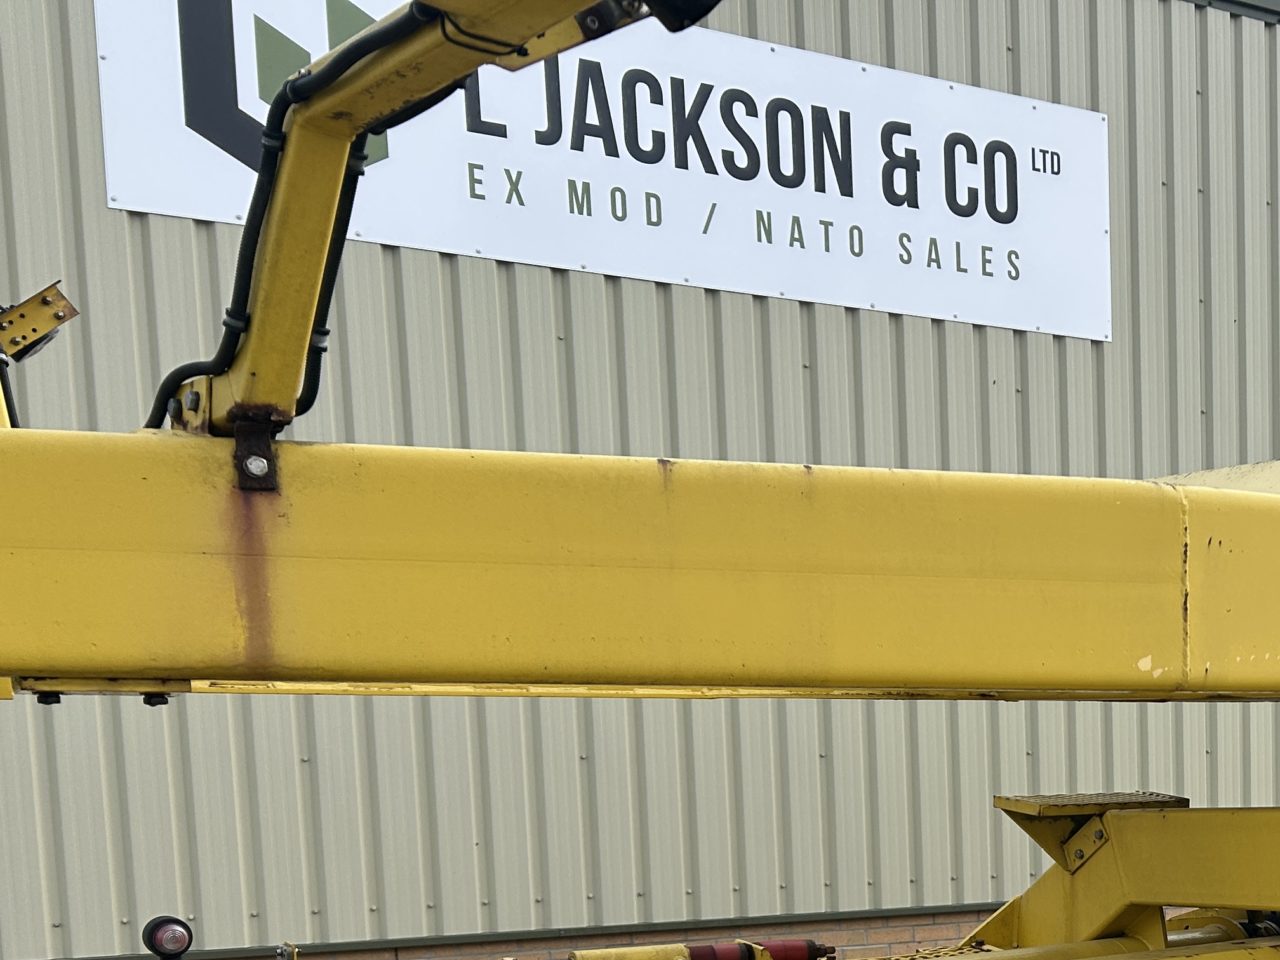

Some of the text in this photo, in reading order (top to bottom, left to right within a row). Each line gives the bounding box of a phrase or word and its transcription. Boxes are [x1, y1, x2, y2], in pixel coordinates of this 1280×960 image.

[464, 53, 1062, 225] L JACKSON & CO LTD
[467, 162, 1020, 282] EX MOD / NATO SALES
